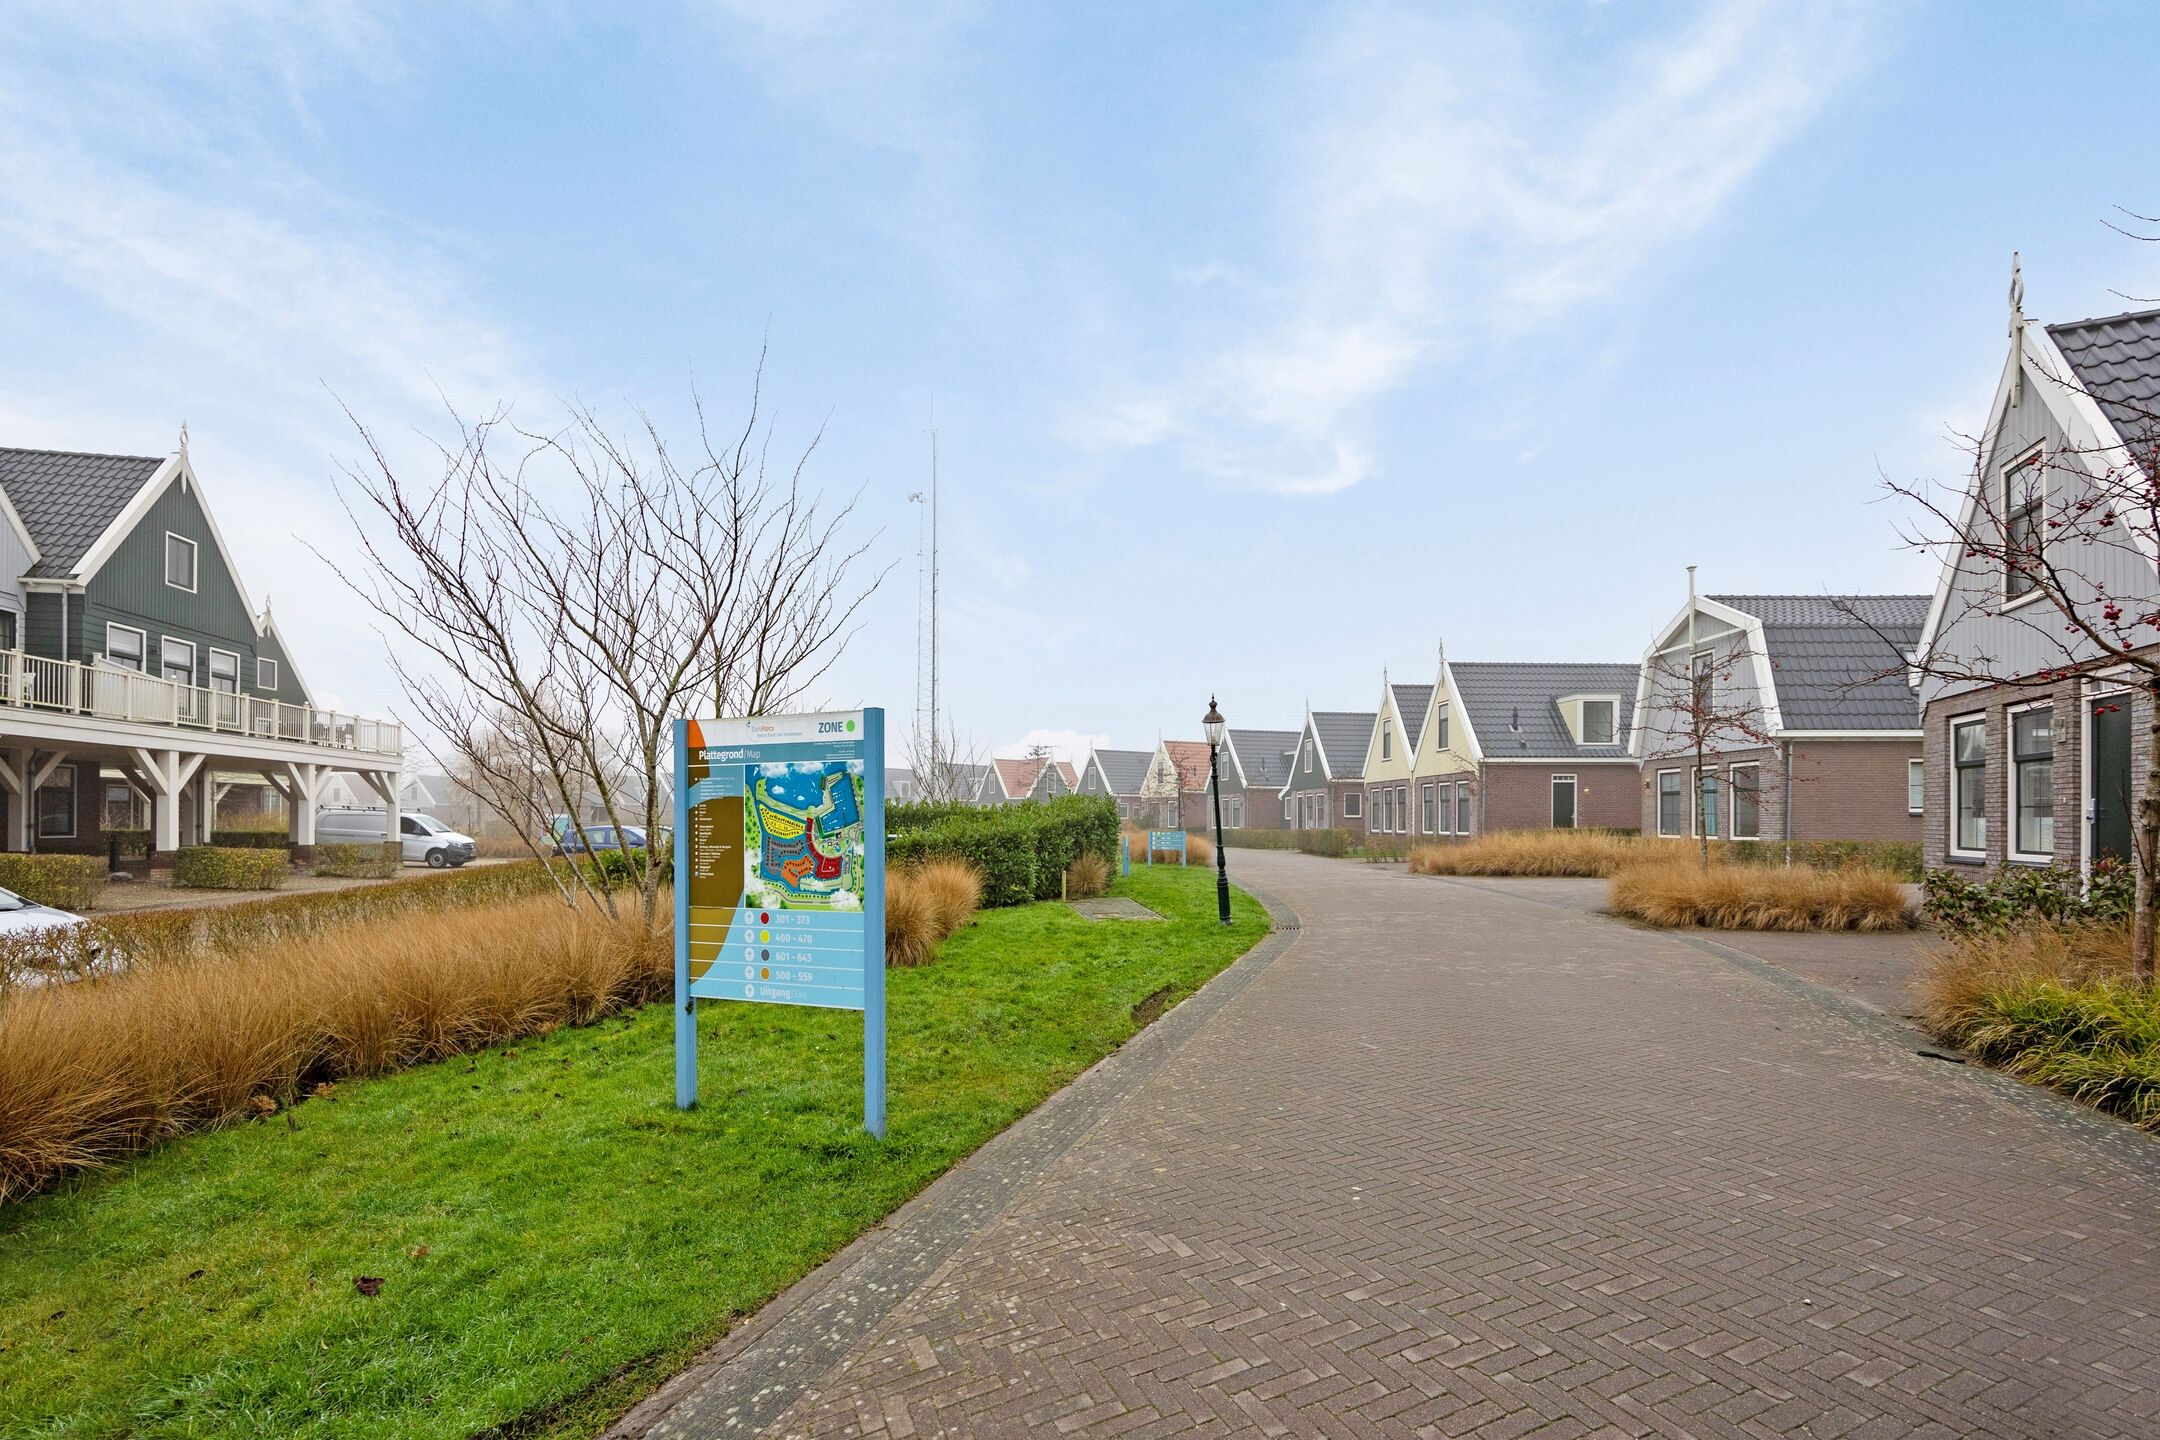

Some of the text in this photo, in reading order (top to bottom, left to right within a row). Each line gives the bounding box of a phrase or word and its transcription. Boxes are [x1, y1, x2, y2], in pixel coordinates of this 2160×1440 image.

[818, 721, 843, 734] ZONE
[775, 914, 789, 924] 301
[796, 915, 810, 925] 373
[775, 932, 790, 943] 400
[798, 934, 813, 944] 470
[775, 952, 790, 961] 601
[797, 953, 812, 963] 643
[798, 972, 813, 982] 559
